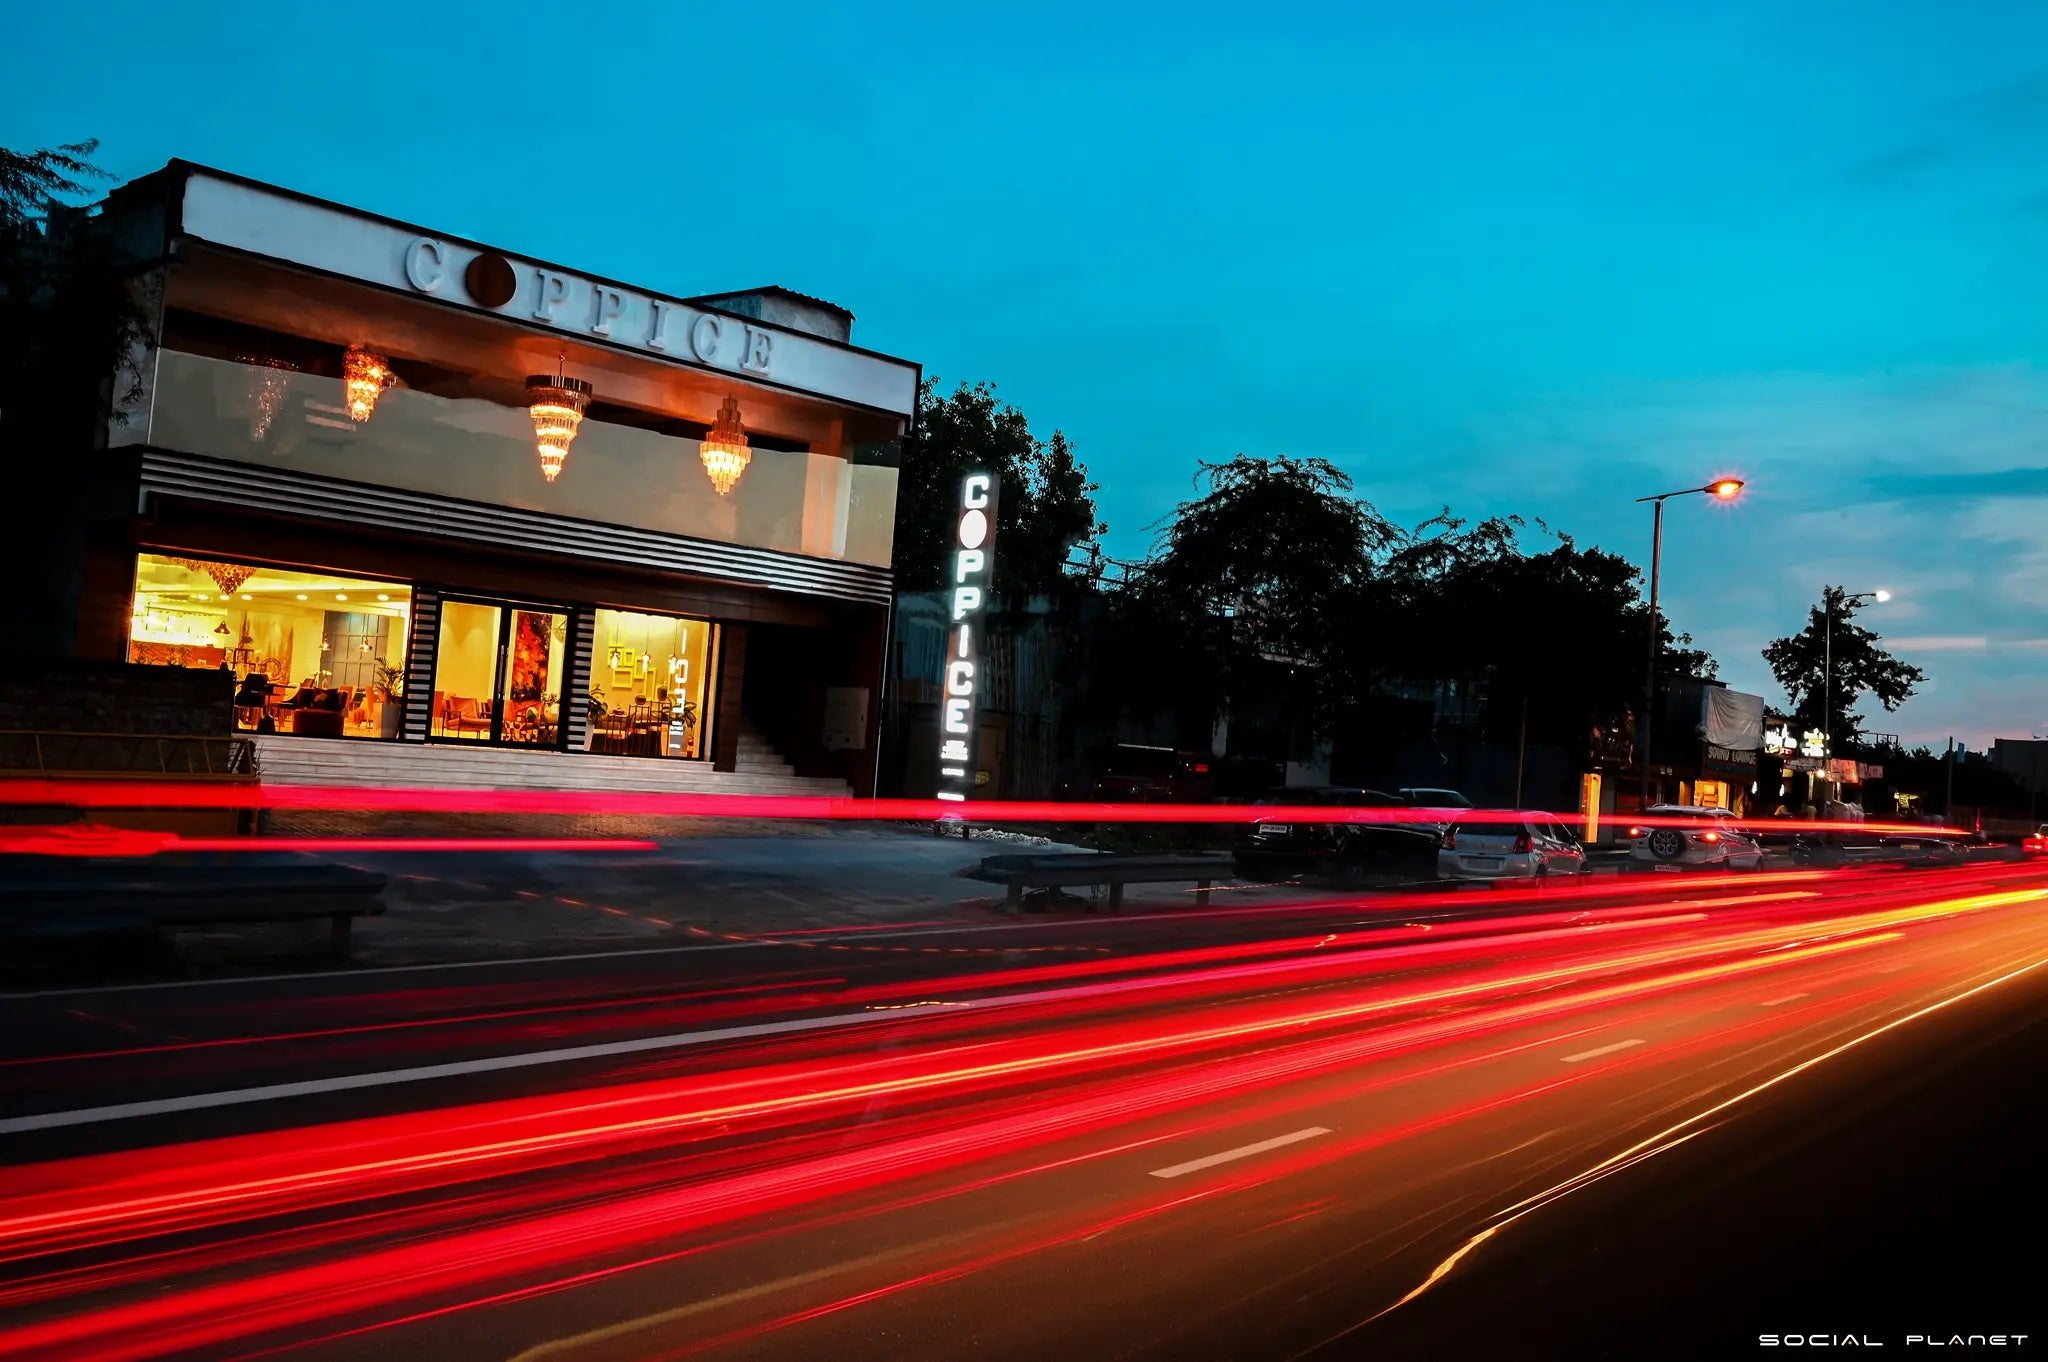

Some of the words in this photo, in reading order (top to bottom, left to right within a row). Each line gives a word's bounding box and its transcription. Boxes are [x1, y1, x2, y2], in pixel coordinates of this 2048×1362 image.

[404, 237, 775, 375] COPPICE
[946, 474, 989, 733] COPPICE
[1708, 746, 1729, 761] SOUND
